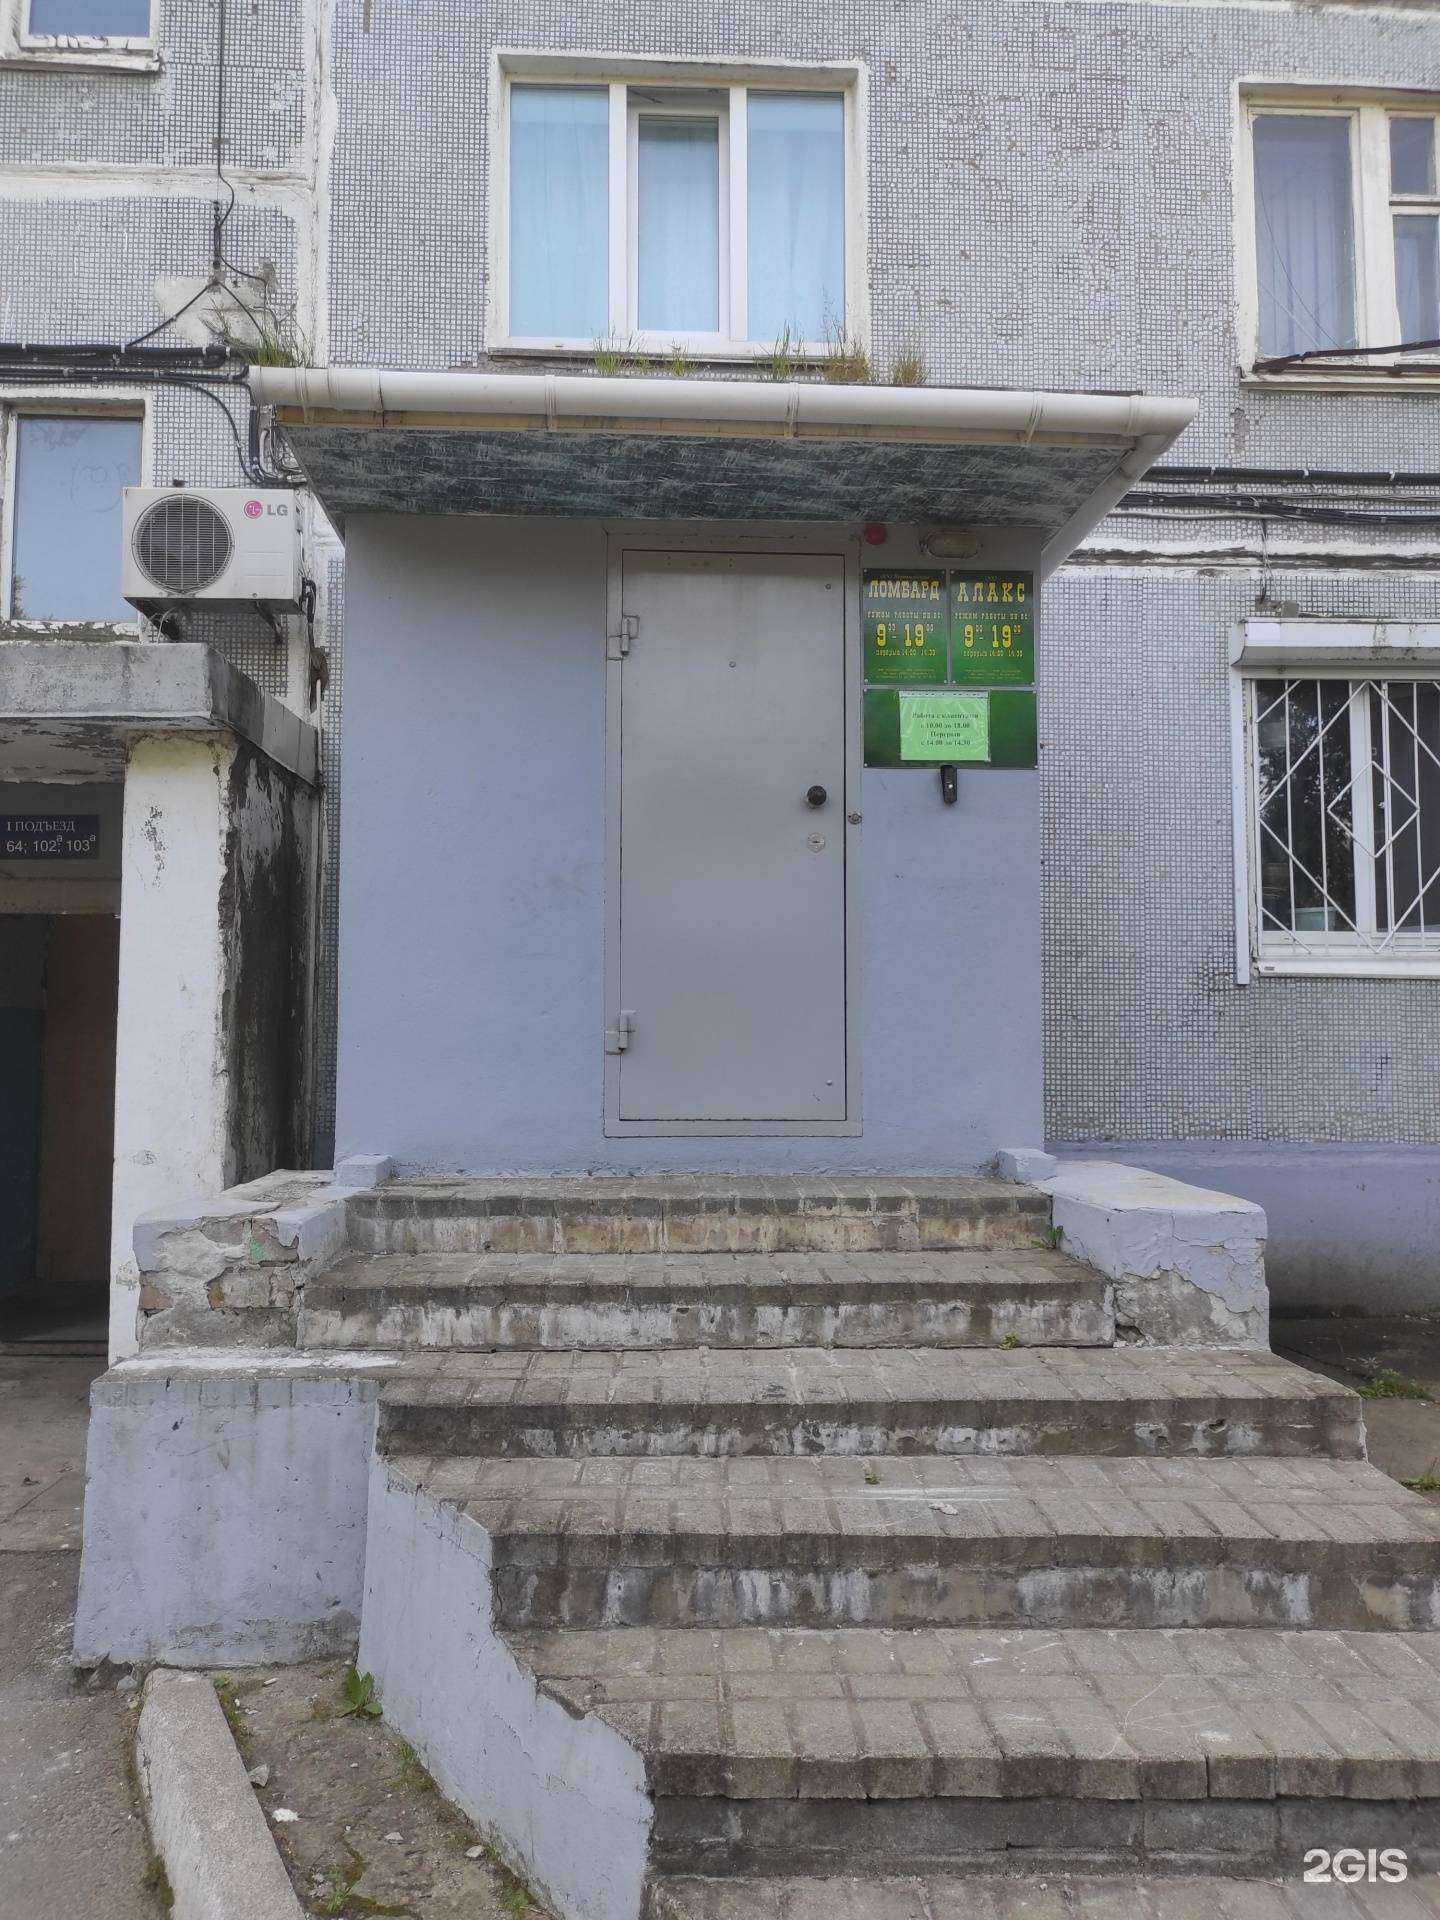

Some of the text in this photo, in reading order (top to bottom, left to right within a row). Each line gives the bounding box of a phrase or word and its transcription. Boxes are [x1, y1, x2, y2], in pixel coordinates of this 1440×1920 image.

[267, 504, 288, 516] LG
[868, 580, 940, 600] ЛОМБАРД
[957, 582, 1025, 602] АЛАКС
[15, 821, 76, 833] ПОДЪЕЗД
